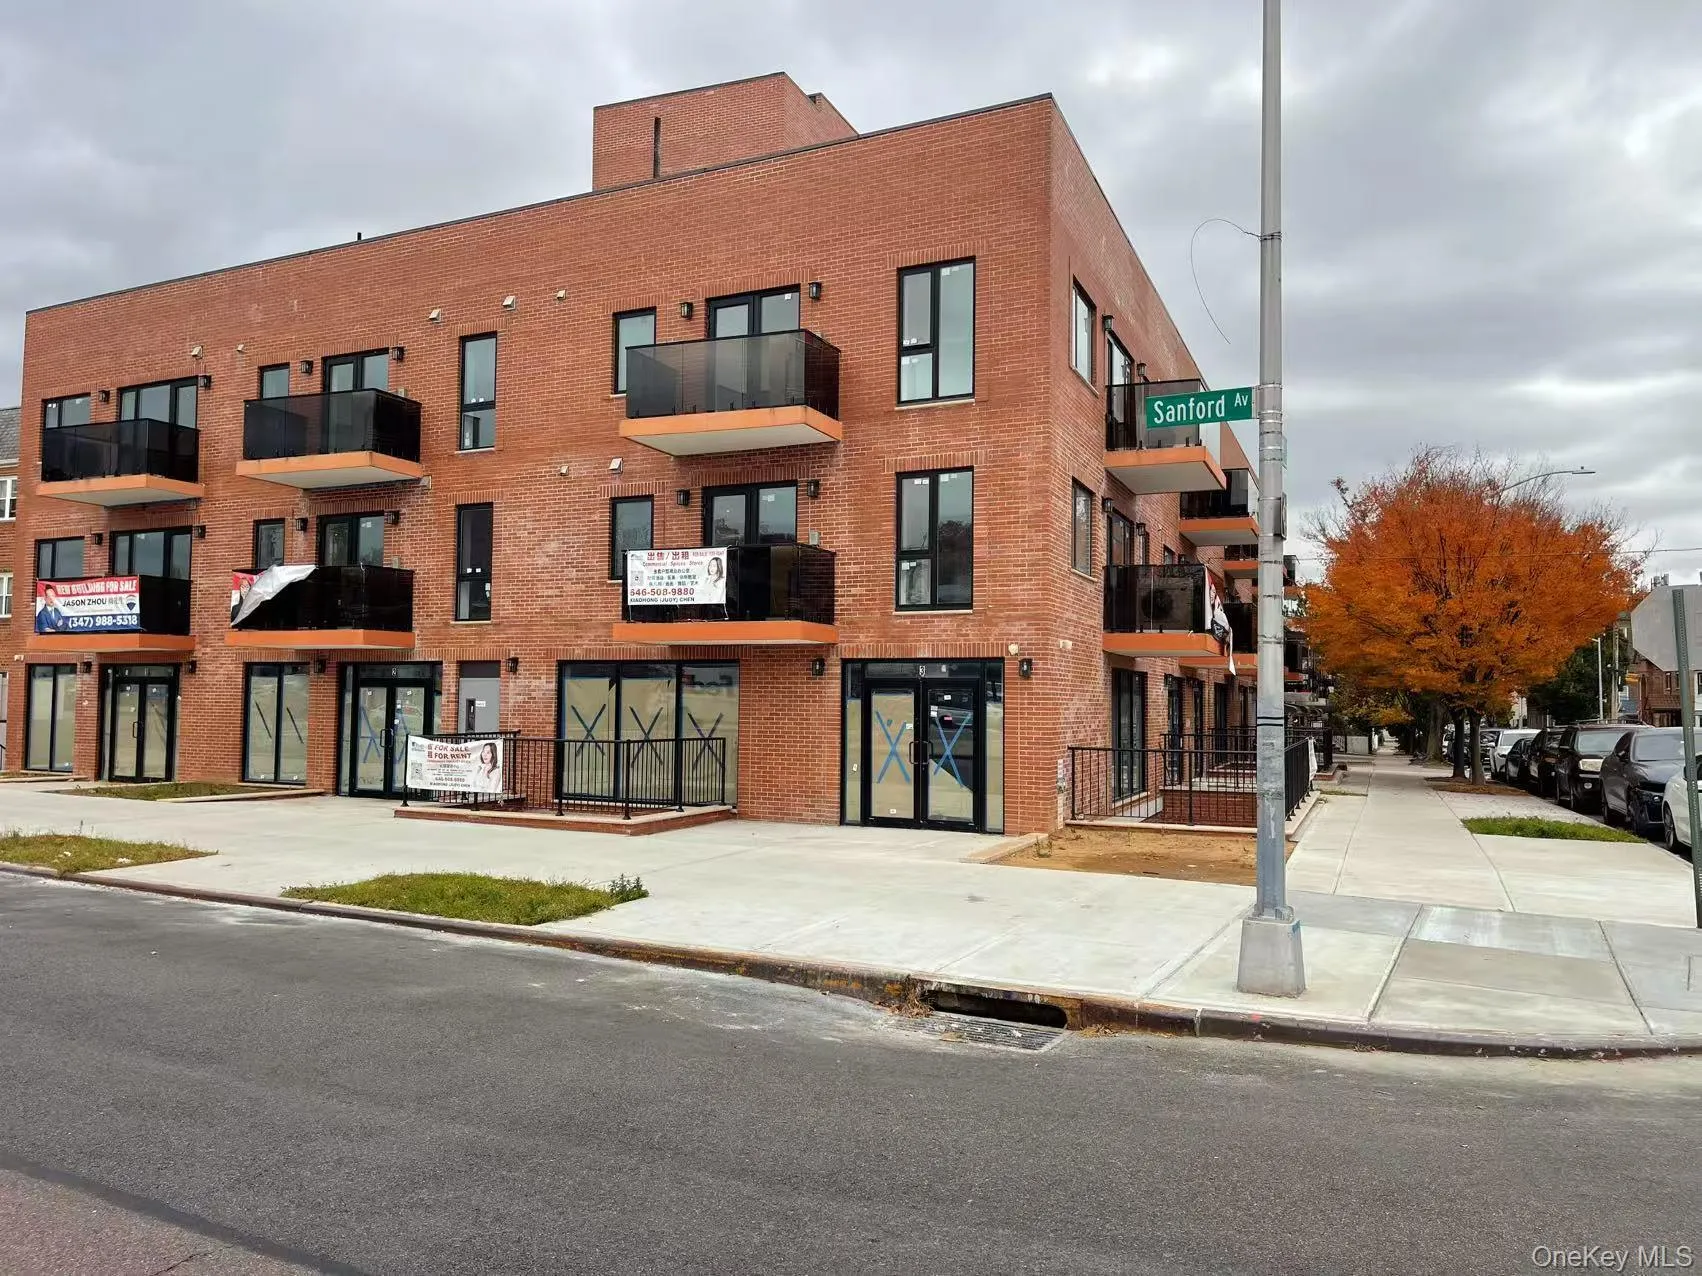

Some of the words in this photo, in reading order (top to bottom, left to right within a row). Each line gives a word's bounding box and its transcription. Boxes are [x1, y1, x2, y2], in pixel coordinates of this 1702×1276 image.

[1153, 395, 1225, 424] Sanford
[1234, 392, 1249, 407] Av
[105, 581, 119, 592] FOR
[119, 580, 137, 591] SALE
[630, 588, 695, 597] 646-508-9880
[62, 598, 86, 607] JASON
[87, 597, 107, 606] ZHOU
[68, 617, 93, 629] (347)
[95, 615, 138, 627] 988-5318
[919, 665, 926, 677] 3
